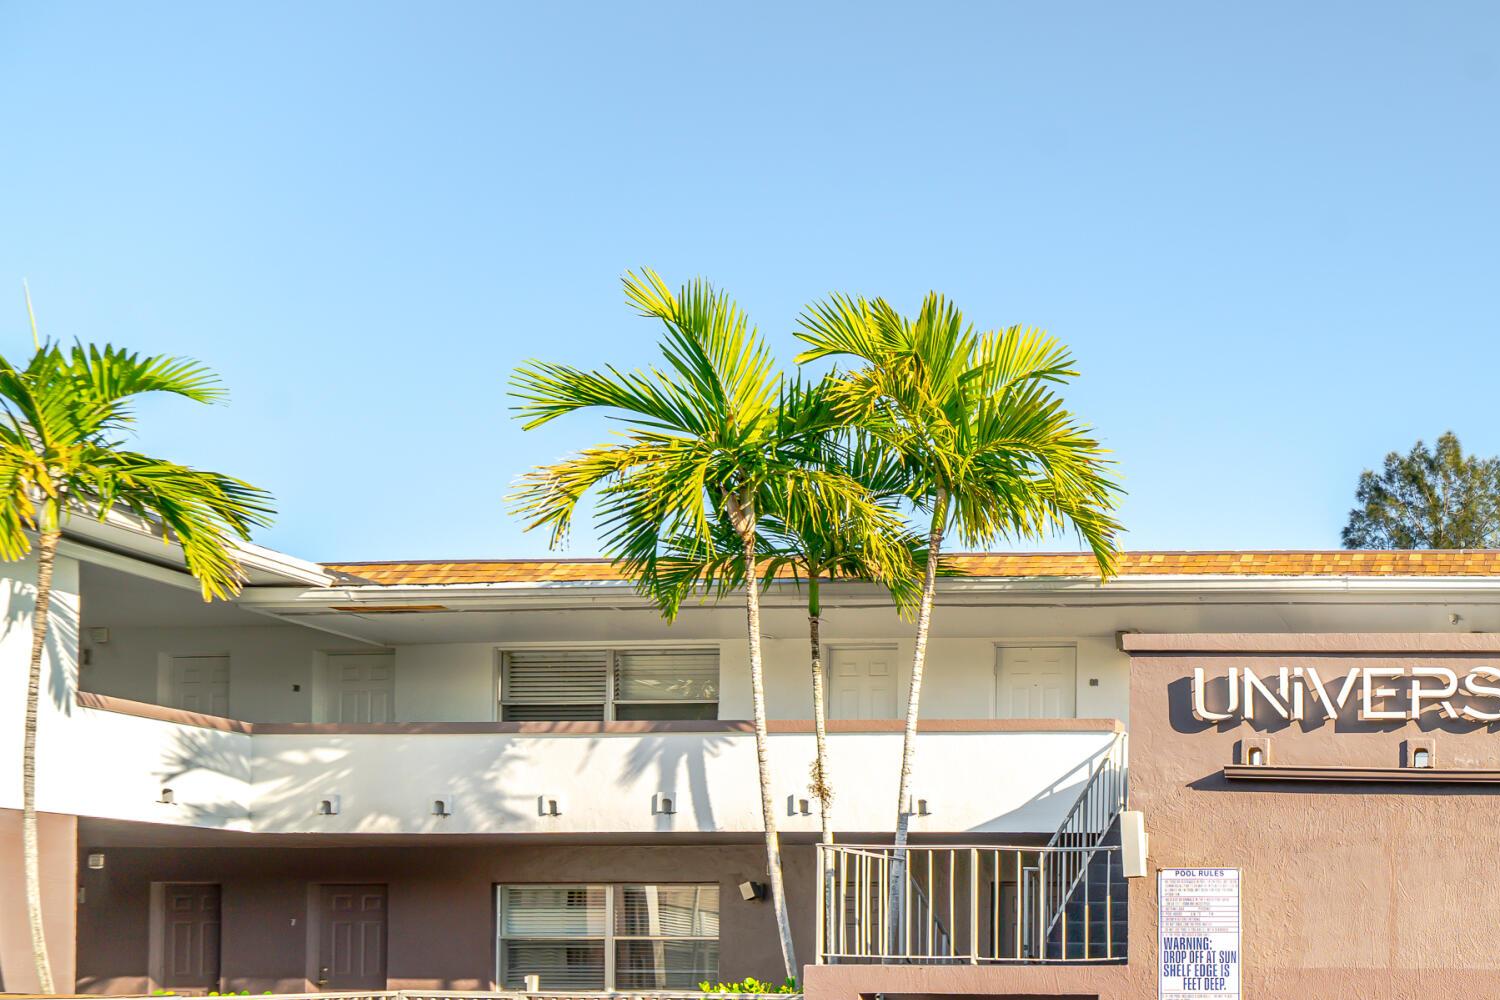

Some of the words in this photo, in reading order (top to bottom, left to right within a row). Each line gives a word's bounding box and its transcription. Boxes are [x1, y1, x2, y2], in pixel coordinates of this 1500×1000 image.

[1163, 937, 1212, 950] WARNING:
[1163, 951, 1187, 963] DROP
[1189, 951, 1204, 963] OFF
[1206, 951, 1216, 963] AT
[1219, 951, 1237, 963] SUN
[1163, 964, 1191, 977] SHELF
[1194, 964, 1217, 977] EDGE
[1220, 964, 1230, 977] IS
[1183, 977, 1202, 990] FEET
[1204, 977, 1227, 990] DEEP.
